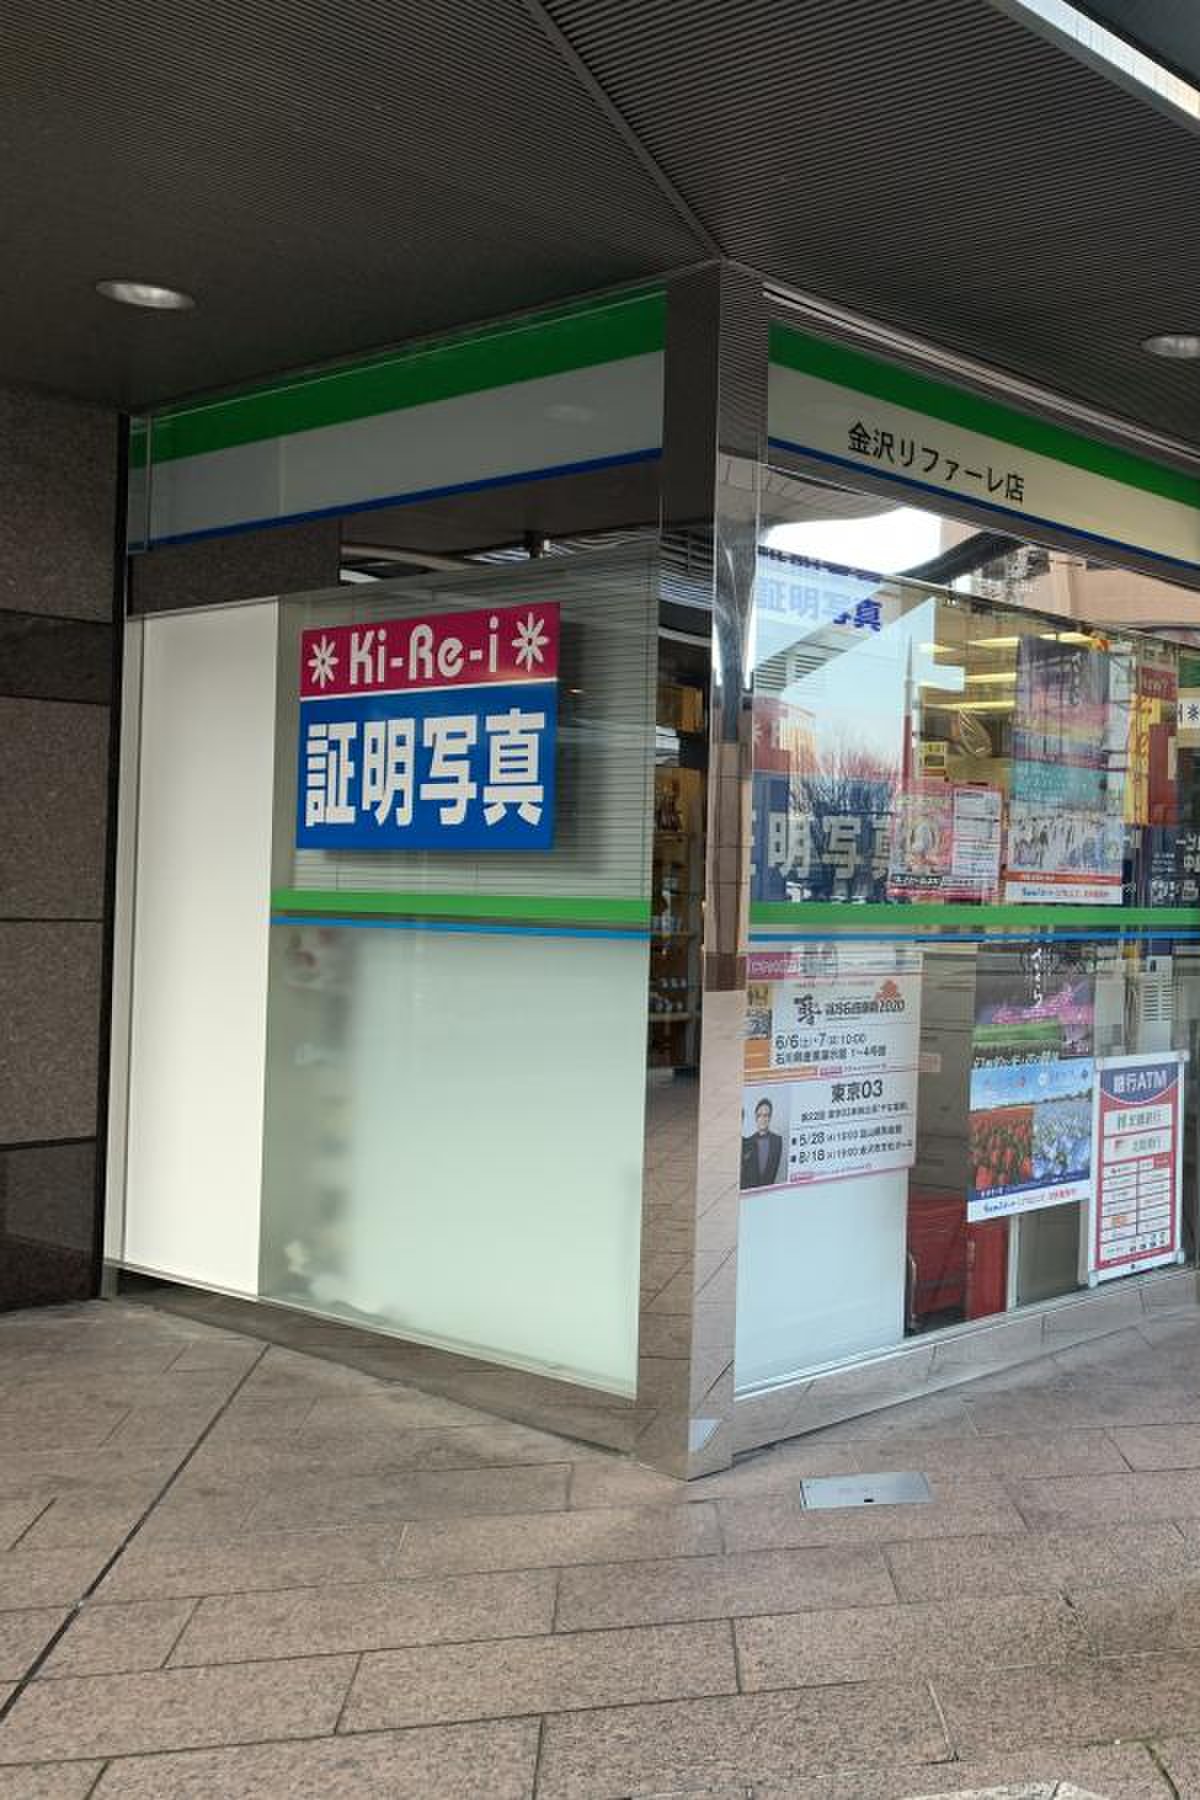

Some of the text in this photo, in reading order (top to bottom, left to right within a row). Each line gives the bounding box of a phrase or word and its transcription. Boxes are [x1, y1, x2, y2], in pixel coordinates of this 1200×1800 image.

[848, 421, 1025, 504] 金沢リファーレ店
[350, 615, 500, 685] Ki-Re-i
[304, 707, 546, 827] 証明写真
[831, 1079, 884, 1104] 東京03
